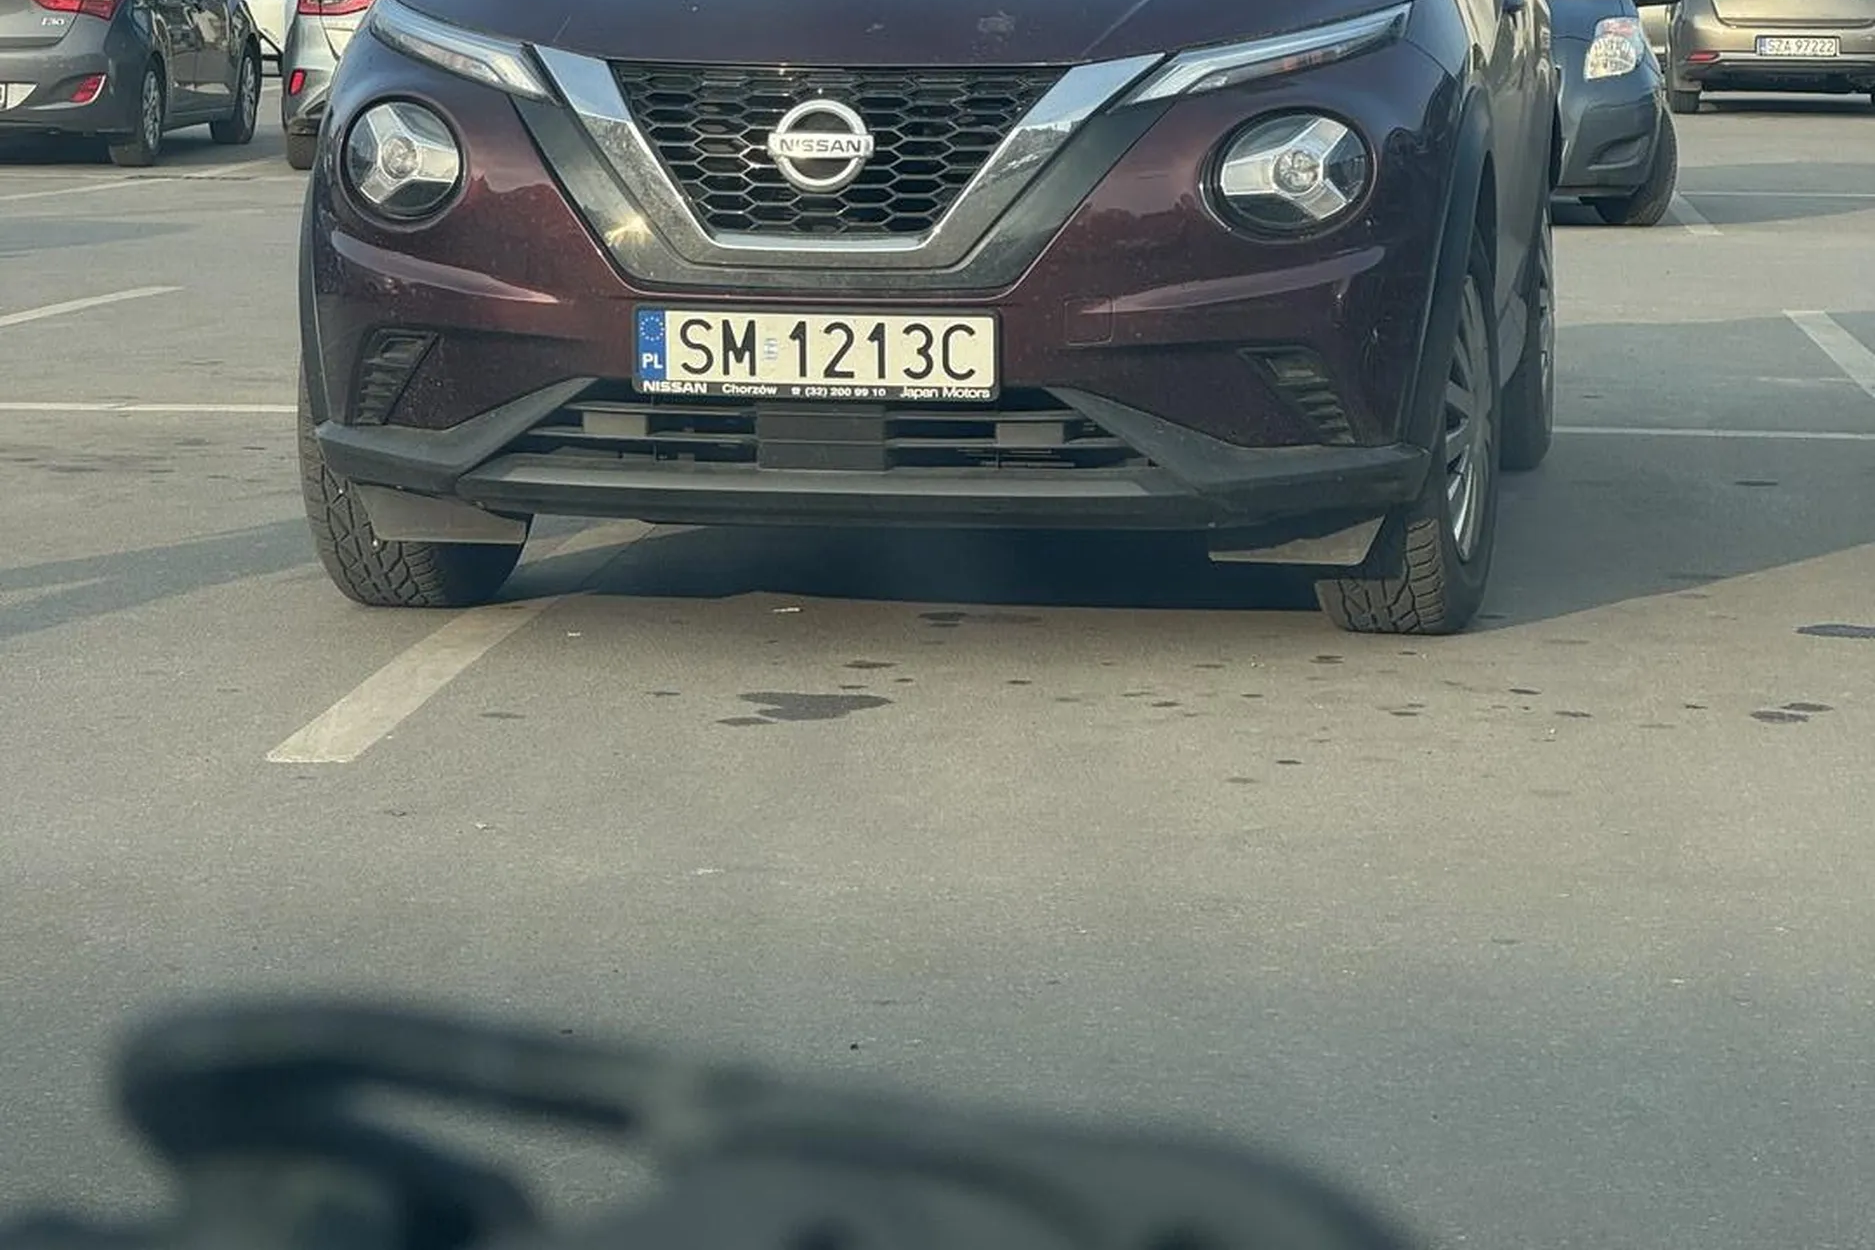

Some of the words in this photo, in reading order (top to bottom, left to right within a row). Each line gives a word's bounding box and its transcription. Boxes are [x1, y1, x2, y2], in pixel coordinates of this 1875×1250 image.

[1795, 39, 1834, 53] 97222
[780, 138, 861, 153] NISSAN
[680, 319, 756, 376] SM
[789, 320, 976, 381] 1213C
[642, 354, 663, 369] PL
[642, 381, 708, 394] NISSAN
[721, 383, 778, 396] Chorzów
[899, 385, 939, 400] Japan
[942, 387, 991, 399] Motors
